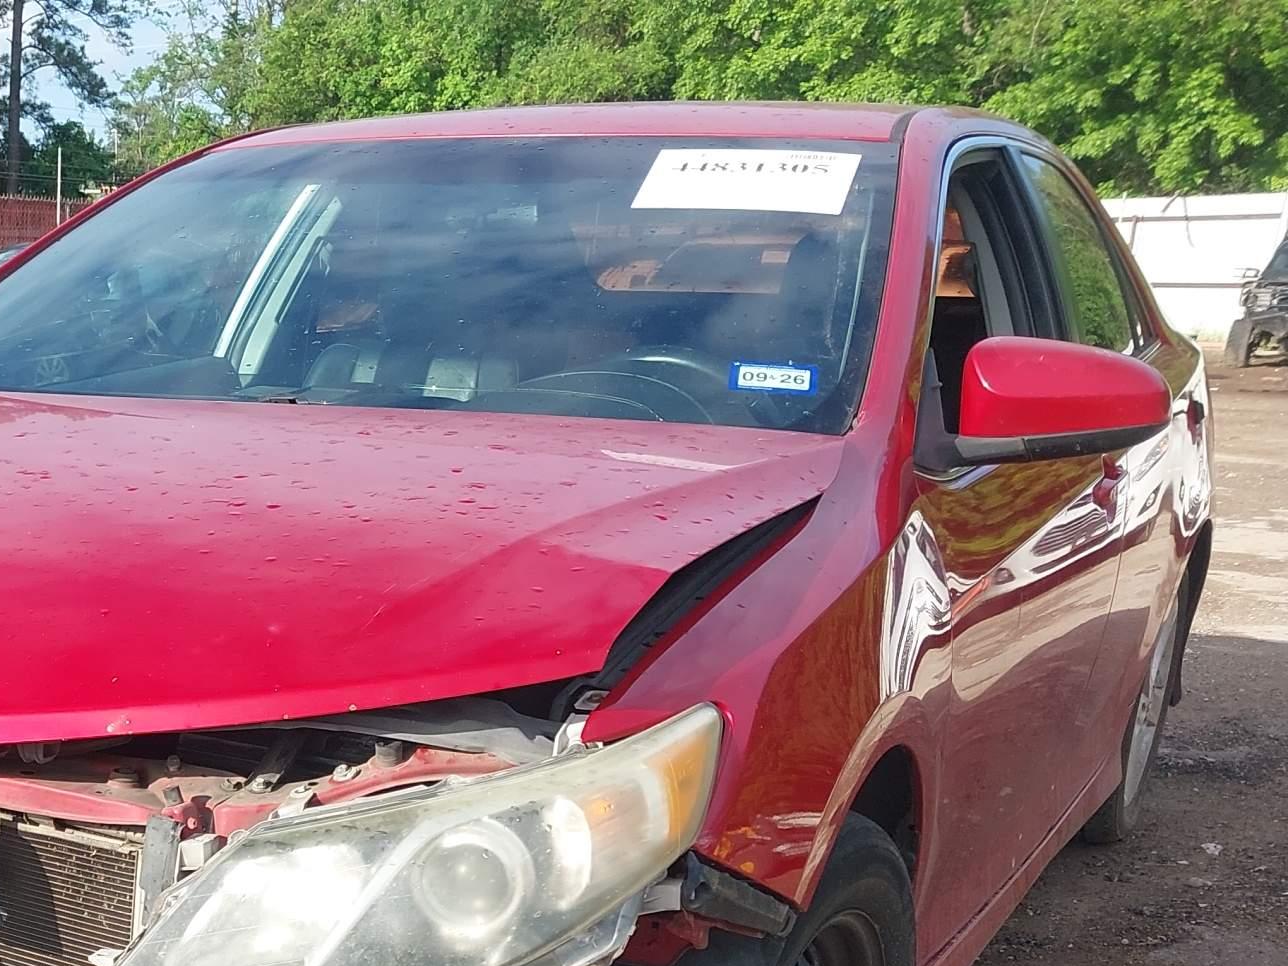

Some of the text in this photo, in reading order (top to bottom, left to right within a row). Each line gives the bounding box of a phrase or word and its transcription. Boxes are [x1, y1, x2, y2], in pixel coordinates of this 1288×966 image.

[672, 162, 831, 174] 44831305
[742, 371, 806, 385] 09 26
